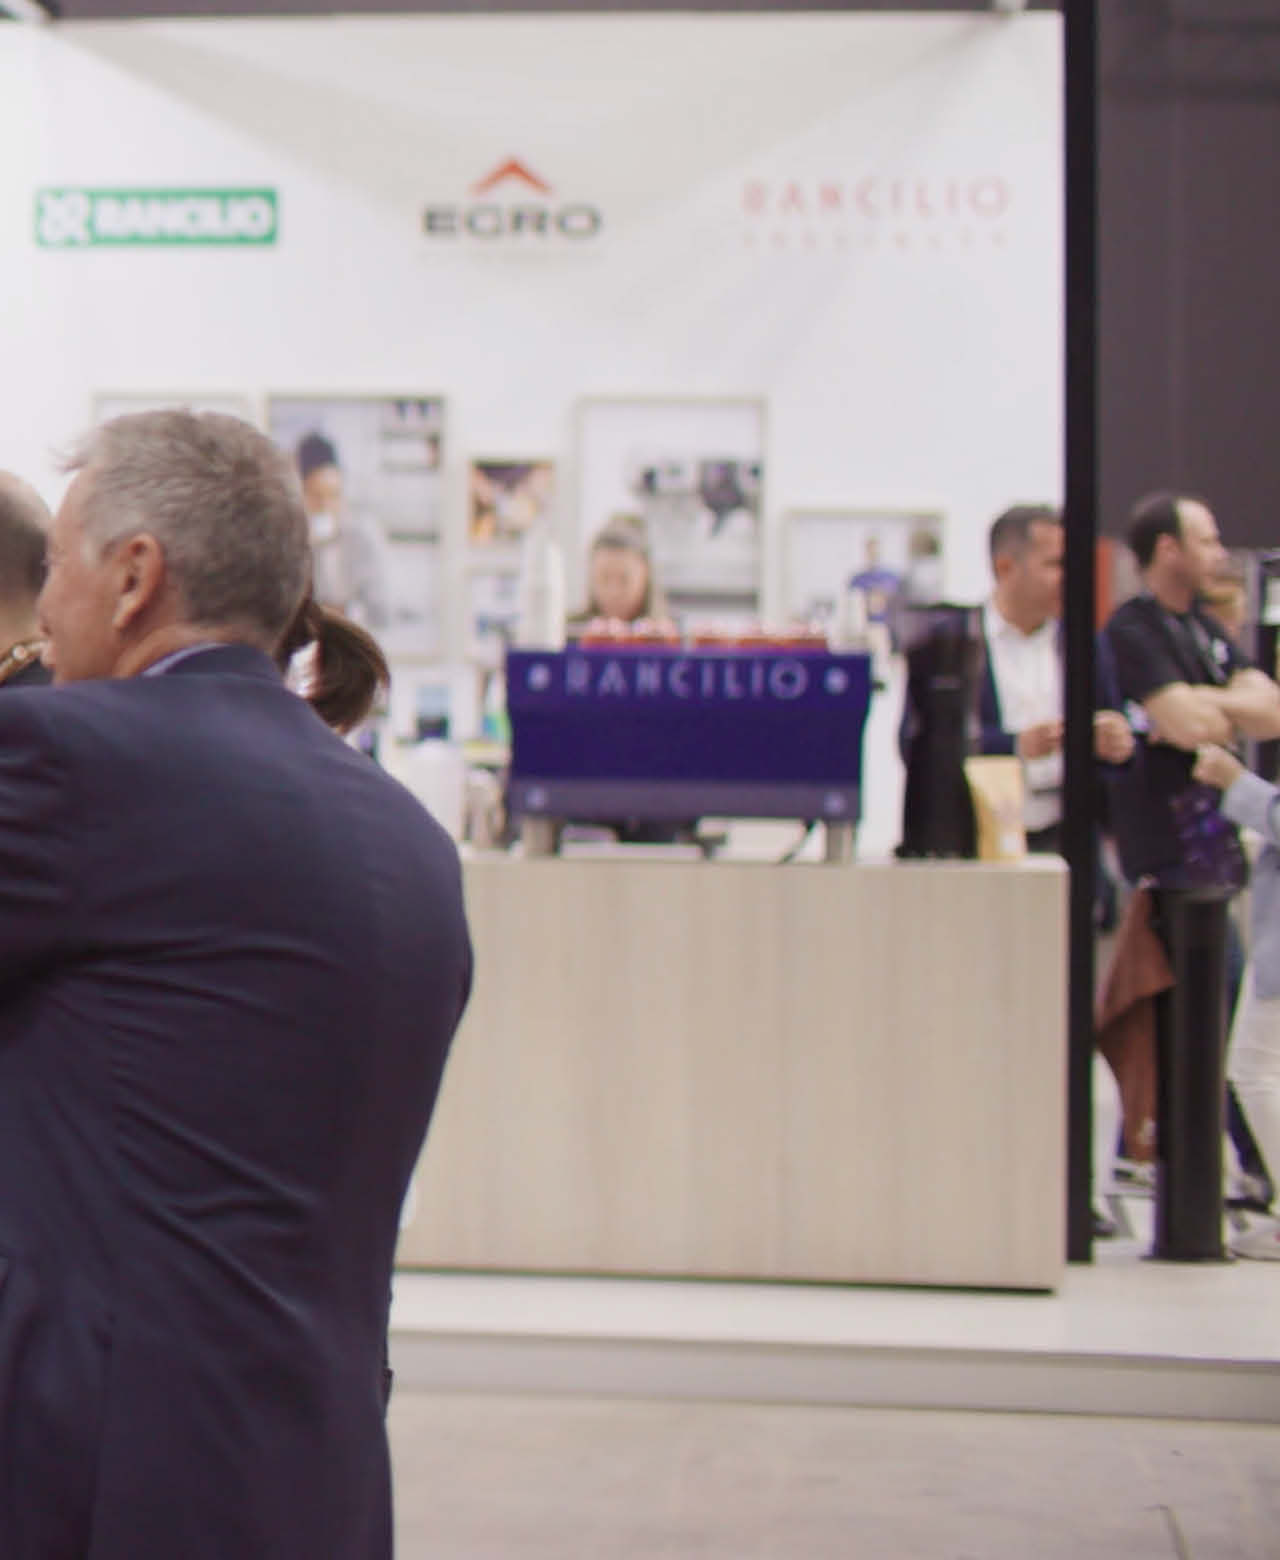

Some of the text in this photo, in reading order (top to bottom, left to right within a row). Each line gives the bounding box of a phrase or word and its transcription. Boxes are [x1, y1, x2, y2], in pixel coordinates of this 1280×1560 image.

[741, 176, 1011, 218] RANCILIO
[423, 204, 602, 241] EGRO
[565, 659, 809, 699] RANCILIO
